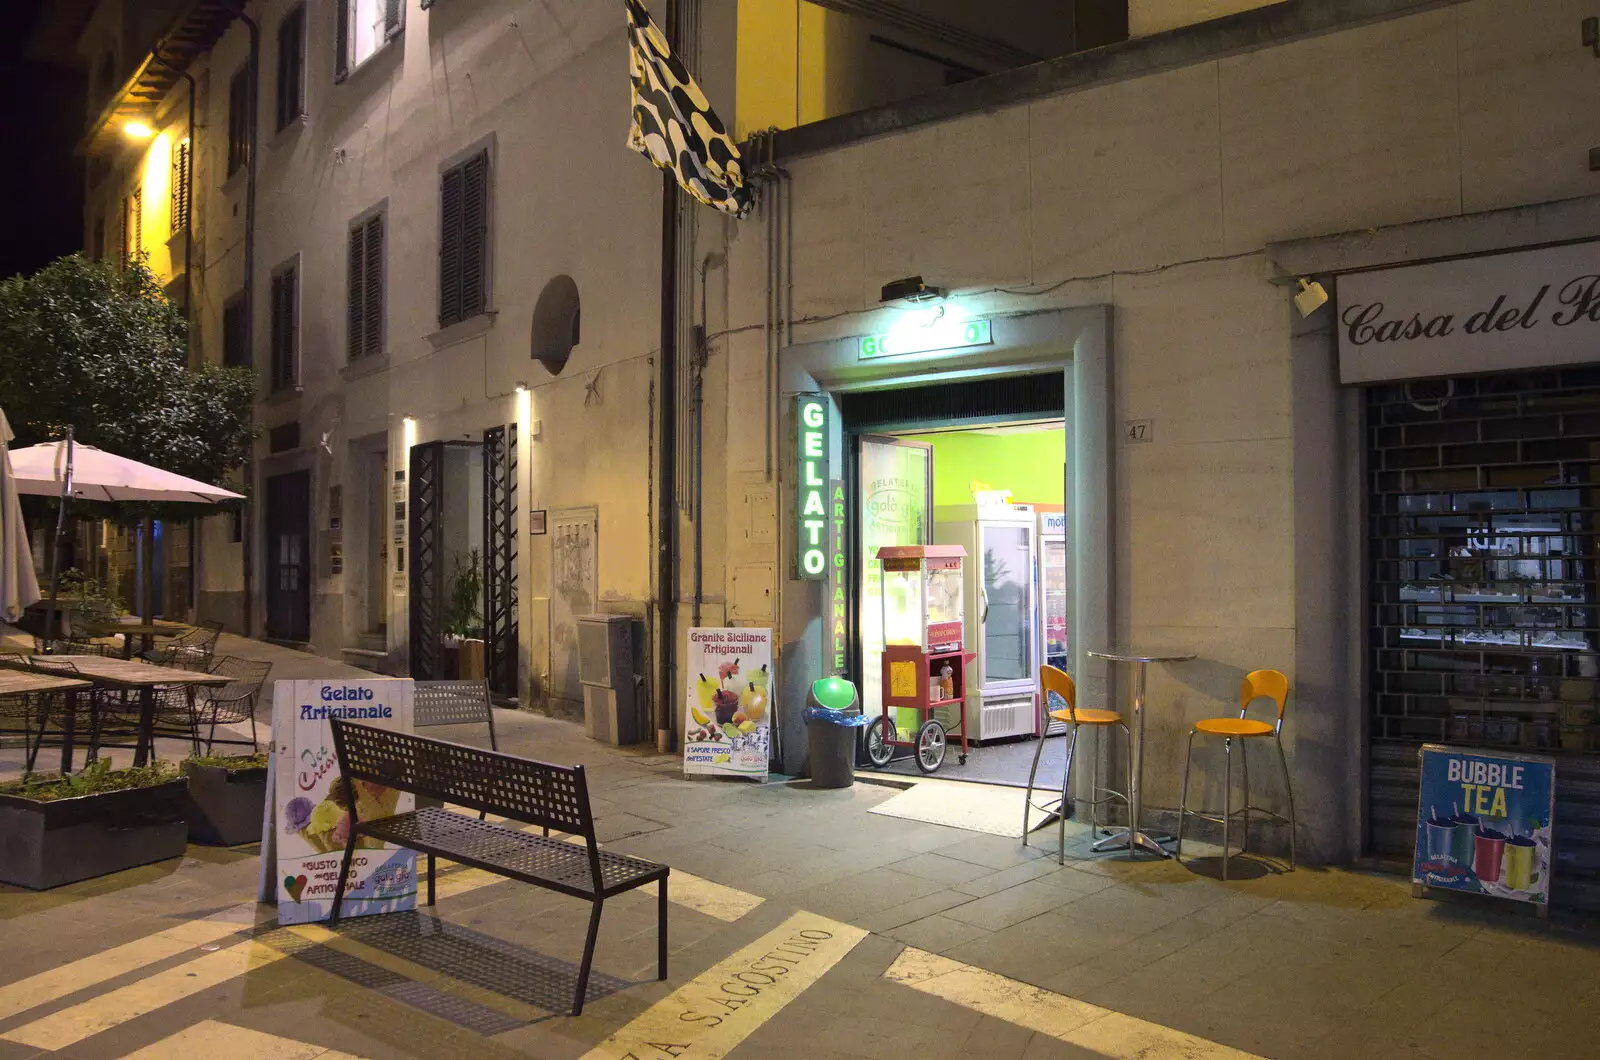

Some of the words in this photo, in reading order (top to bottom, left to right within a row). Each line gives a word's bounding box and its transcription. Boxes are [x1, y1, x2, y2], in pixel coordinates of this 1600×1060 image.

[1341, 301, 1454, 346] Casa
[1463, 284, 1550, 335] del
[1128, 425, 1146, 439] 47
[802, 402, 826, 575] GELATO
[834, 486, 845, 668] ARTIGIANALE
[690, 632, 725, 642] Granite
[727, 632, 766, 642] Siciliane
[704, 644, 752, 656] Artigianali
[320, 686, 374, 701] Gelato
[300, 704, 392, 720] Artigianale
[301, 746, 328, 768] Ice
[1448, 758, 1524, 790] BUBBLE
[1461, 784, 1508, 818] TEA
[306, 860, 337, 870] GUSTO
[322, 870, 358, 880] GELTO
